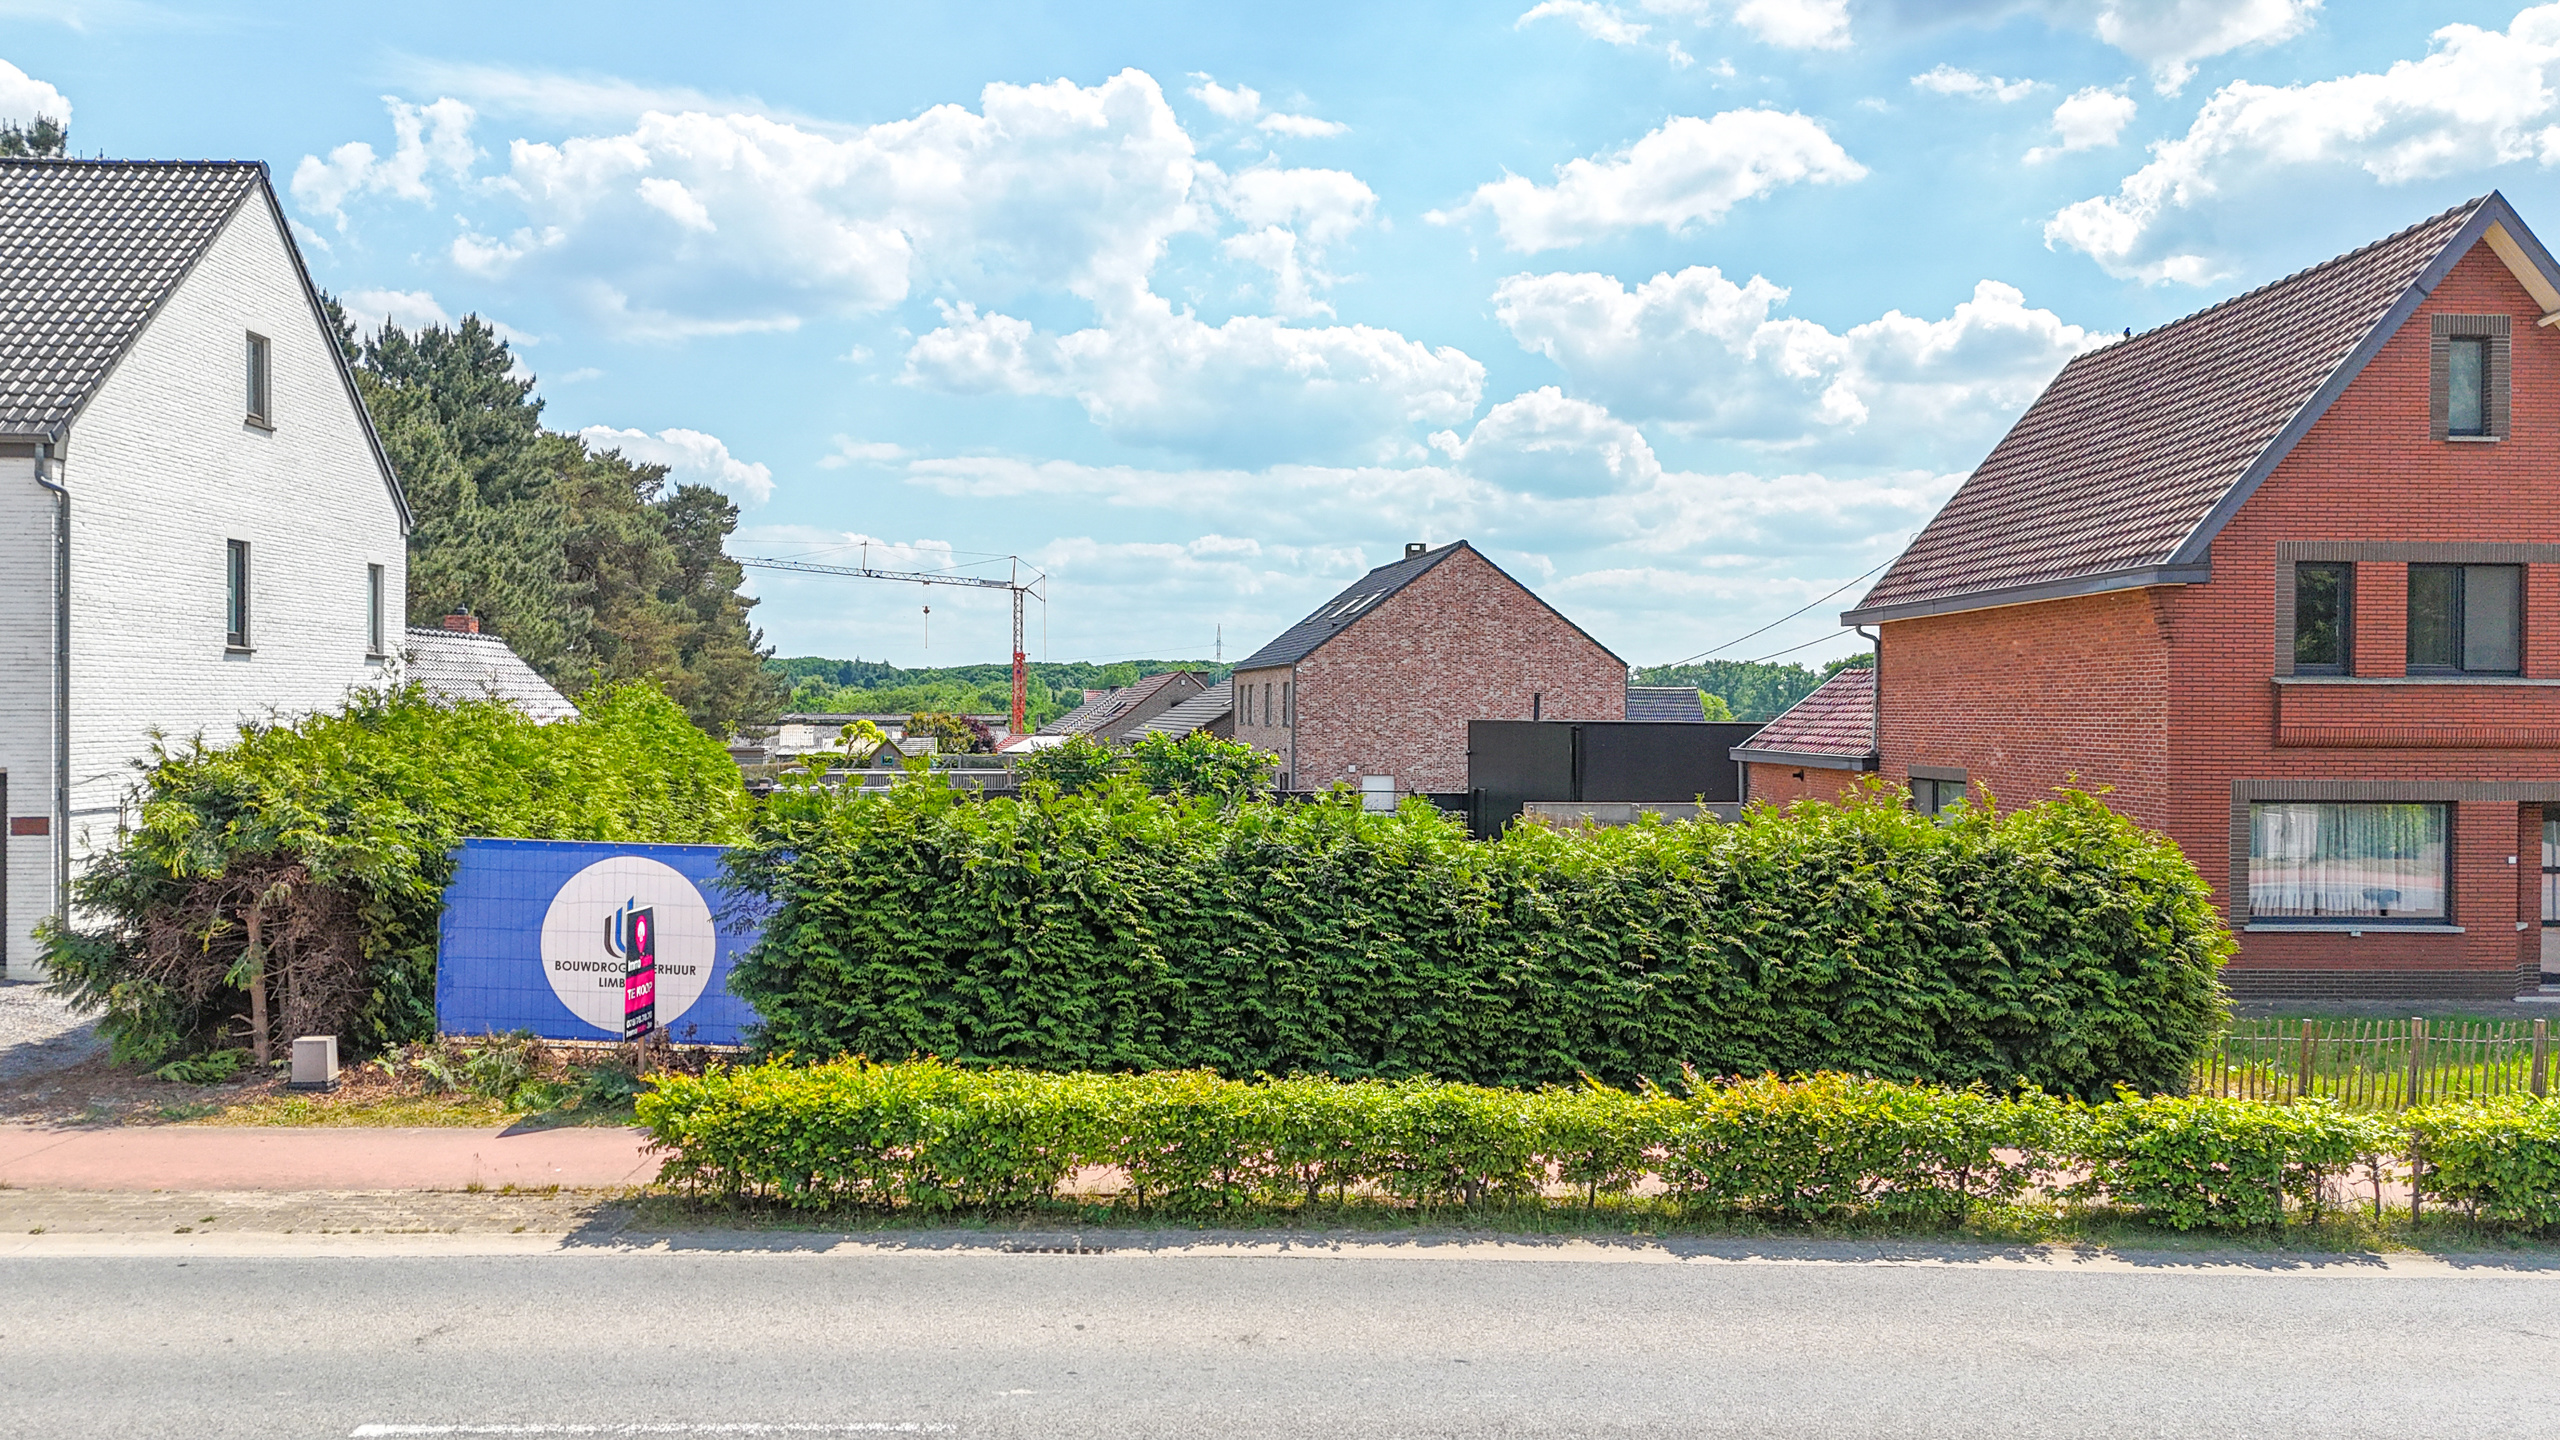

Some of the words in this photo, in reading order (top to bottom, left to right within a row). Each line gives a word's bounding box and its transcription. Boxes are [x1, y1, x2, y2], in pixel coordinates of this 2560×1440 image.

[598, 977, 626, 988] LIMB
[627, 987, 636, 1001] TE
[636, 981, 653, 998] KOOP
